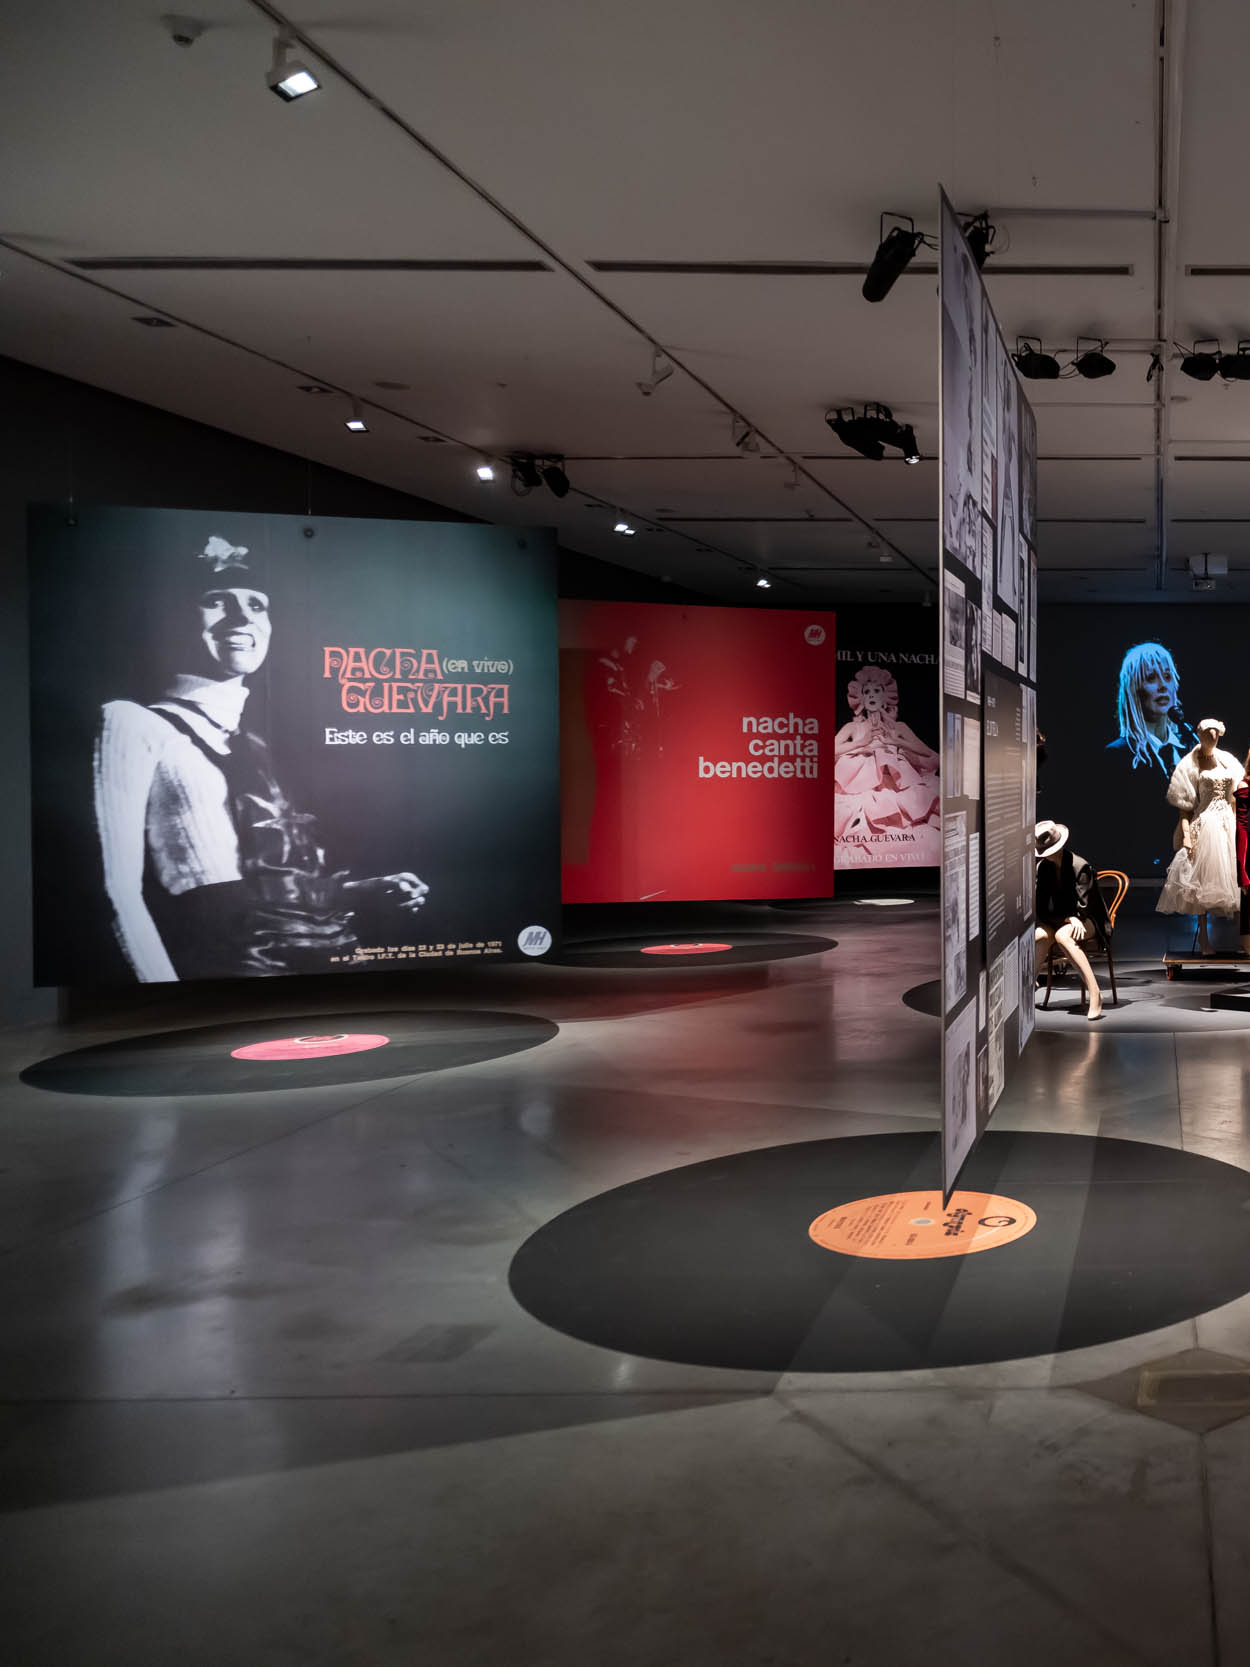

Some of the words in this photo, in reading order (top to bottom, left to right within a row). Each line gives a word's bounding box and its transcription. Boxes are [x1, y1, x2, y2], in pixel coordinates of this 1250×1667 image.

[323, 647, 443, 684] NACHA
[472, 656, 514, 675] vivo)
[856, 651, 865, 662] Y
[867, 651, 896, 663] UNA
[341, 681, 510, 720] GUEVARA
[742, 712, 819, 734] nacha
[325, 728, 367, 745] Este
[372, 731, 394, 744] es
[400, 728, 414, 744] el
[419, 729, 450, 744] año
[454, 731, 484, 748] que
[488, 731, 509, 744] es
[748, 735, 819, 756] canta
[699, 756, 819, 779] benedetti
[870, 834, 915, 843] GUEVARA
